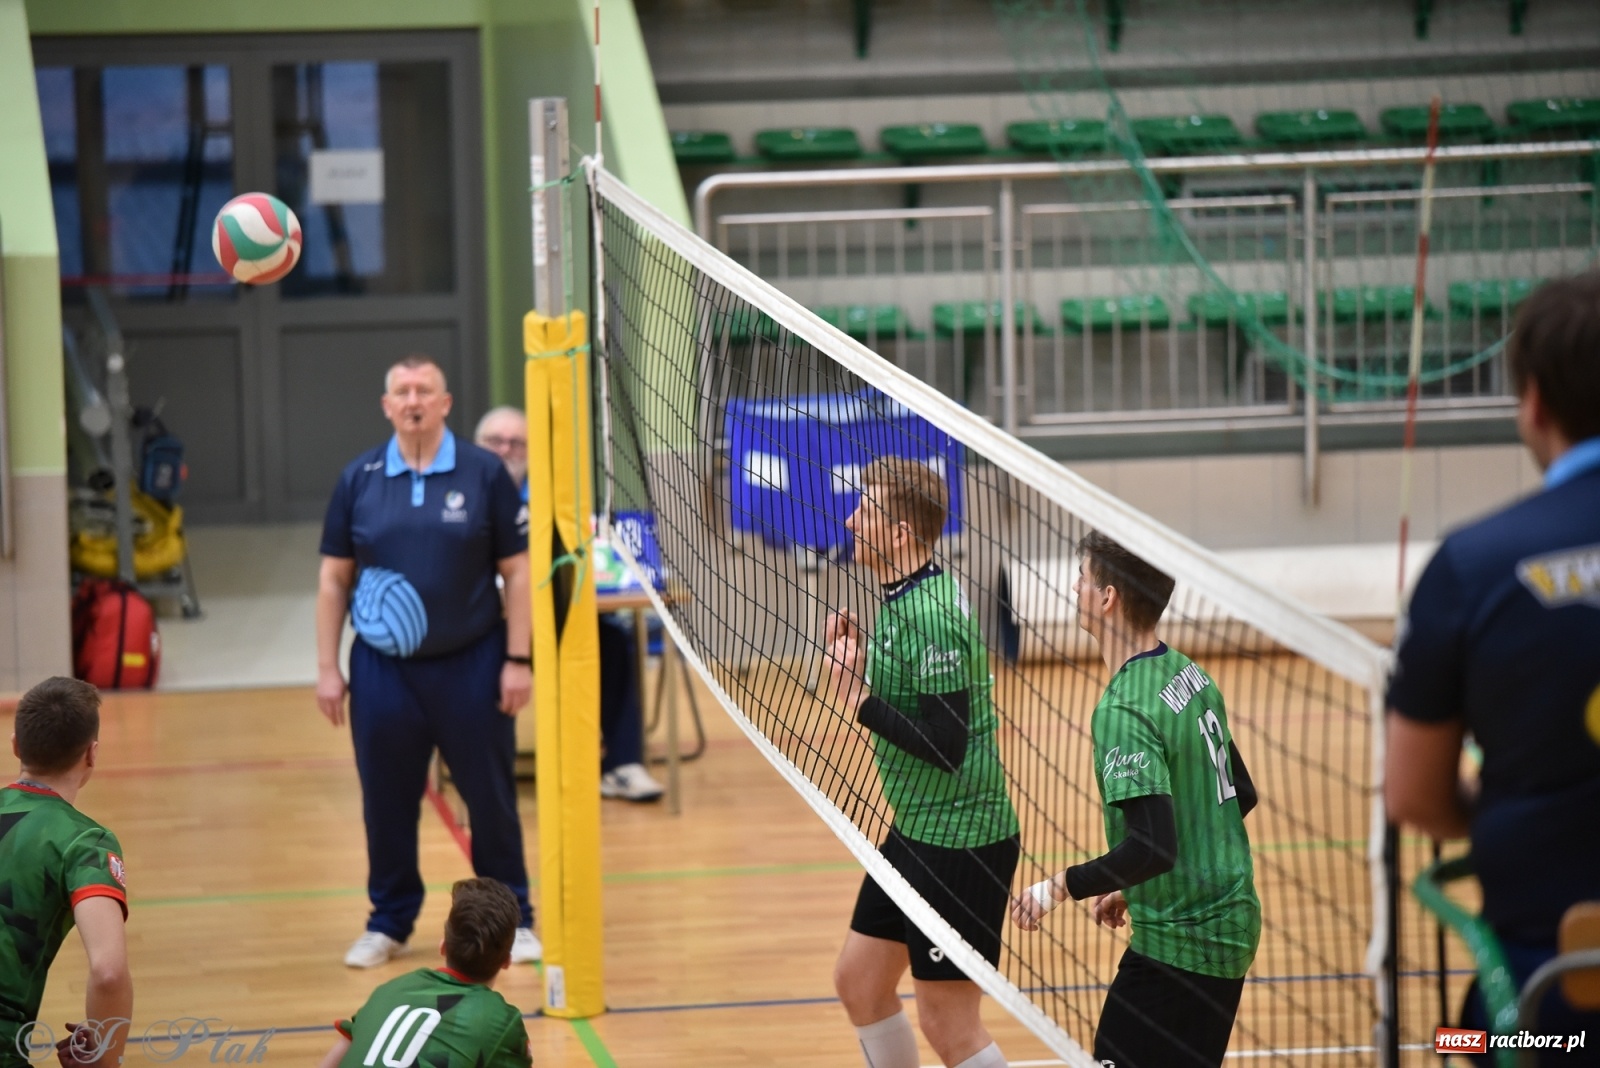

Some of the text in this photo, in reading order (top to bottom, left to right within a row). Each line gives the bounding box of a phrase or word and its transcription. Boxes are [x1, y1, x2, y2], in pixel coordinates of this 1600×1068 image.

[1102, 746, 1151, 782] Jura
[1197, 708, 1237, 806] 12
[362, 1004, 442, 1068] 10
